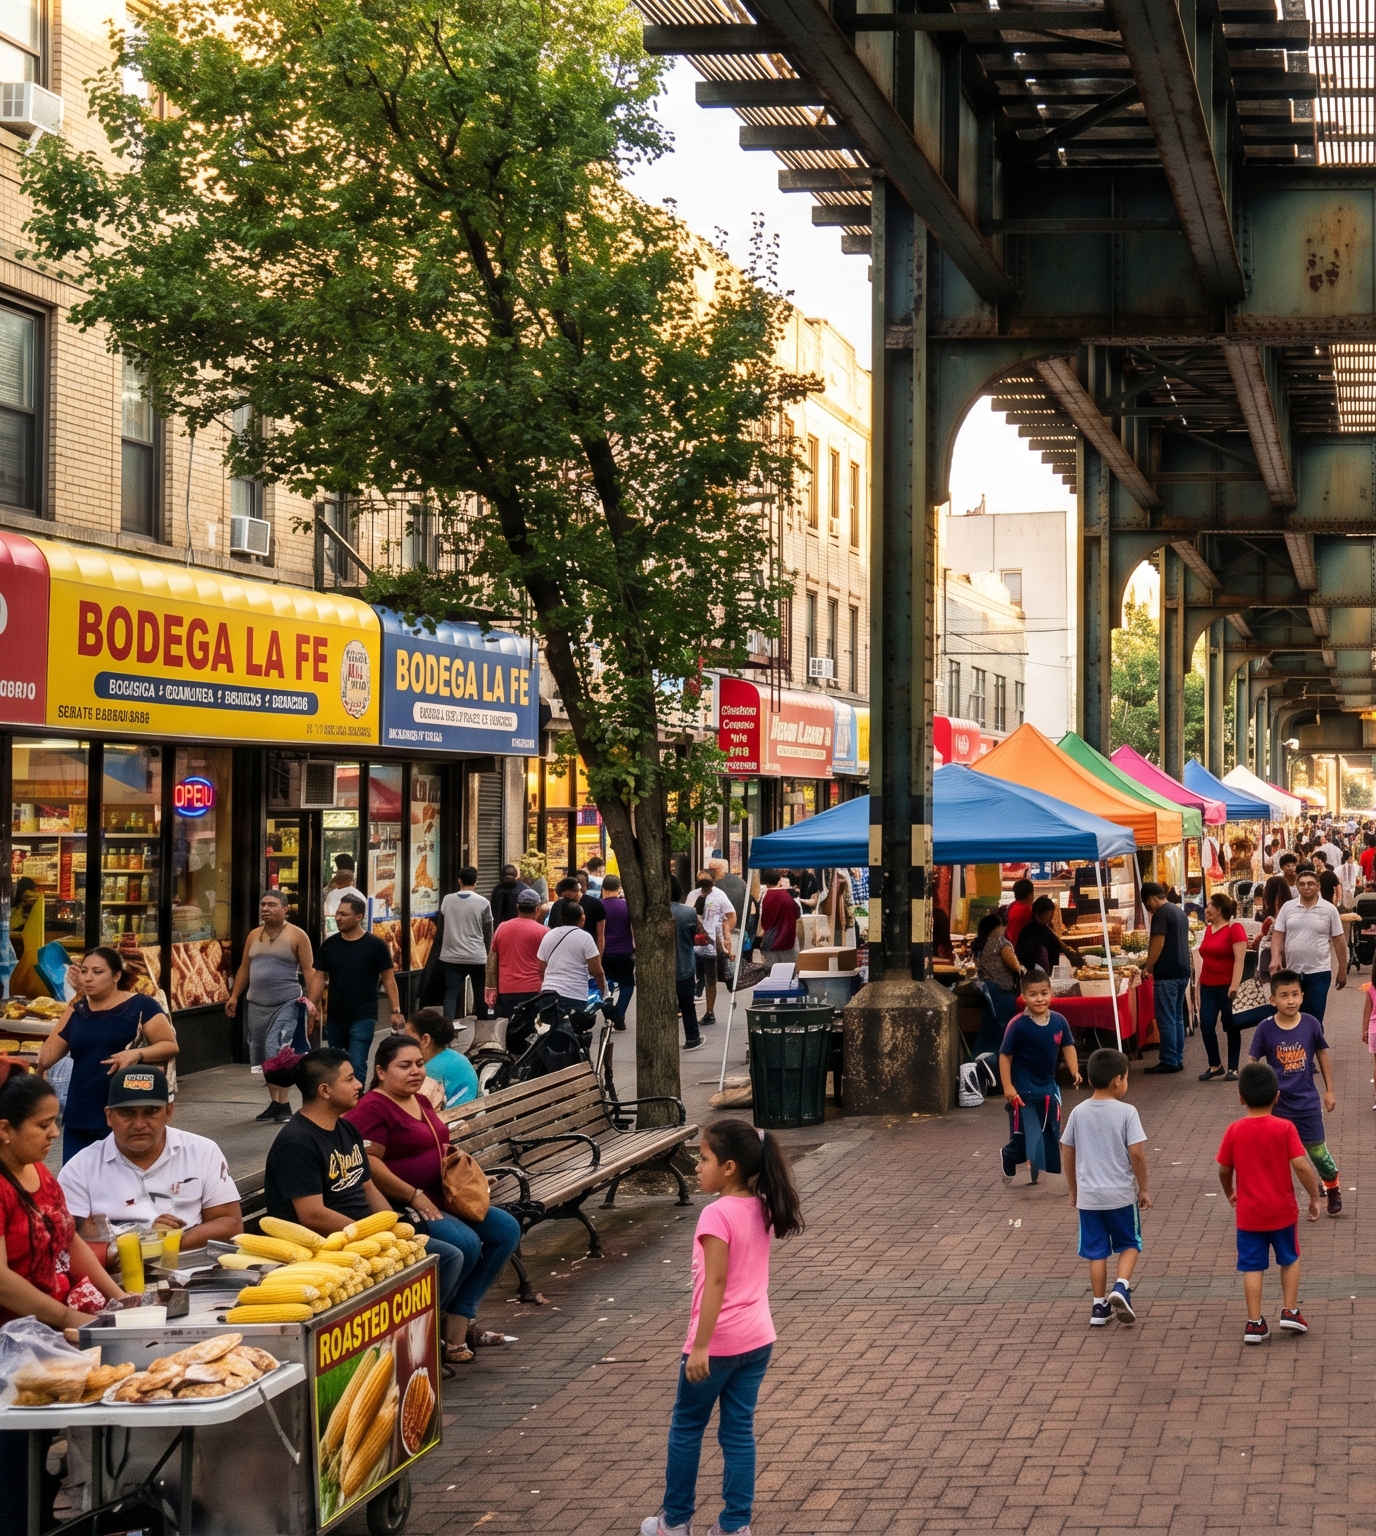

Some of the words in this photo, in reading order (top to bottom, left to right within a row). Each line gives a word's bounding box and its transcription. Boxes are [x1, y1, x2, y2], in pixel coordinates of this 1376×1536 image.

[77, 599, 235, 674] BODEGA
[245, 626, 285, 679] LA
[295, 633, 329, 683] FE
[395, 649, 479, 700] BODEGA
[482, 662, 505, 704] LA
[510, 667, 529, 706] FE
[320, 1300, 390, 1368] ROASTED
[392, 1274, 432, 1325] CORN
